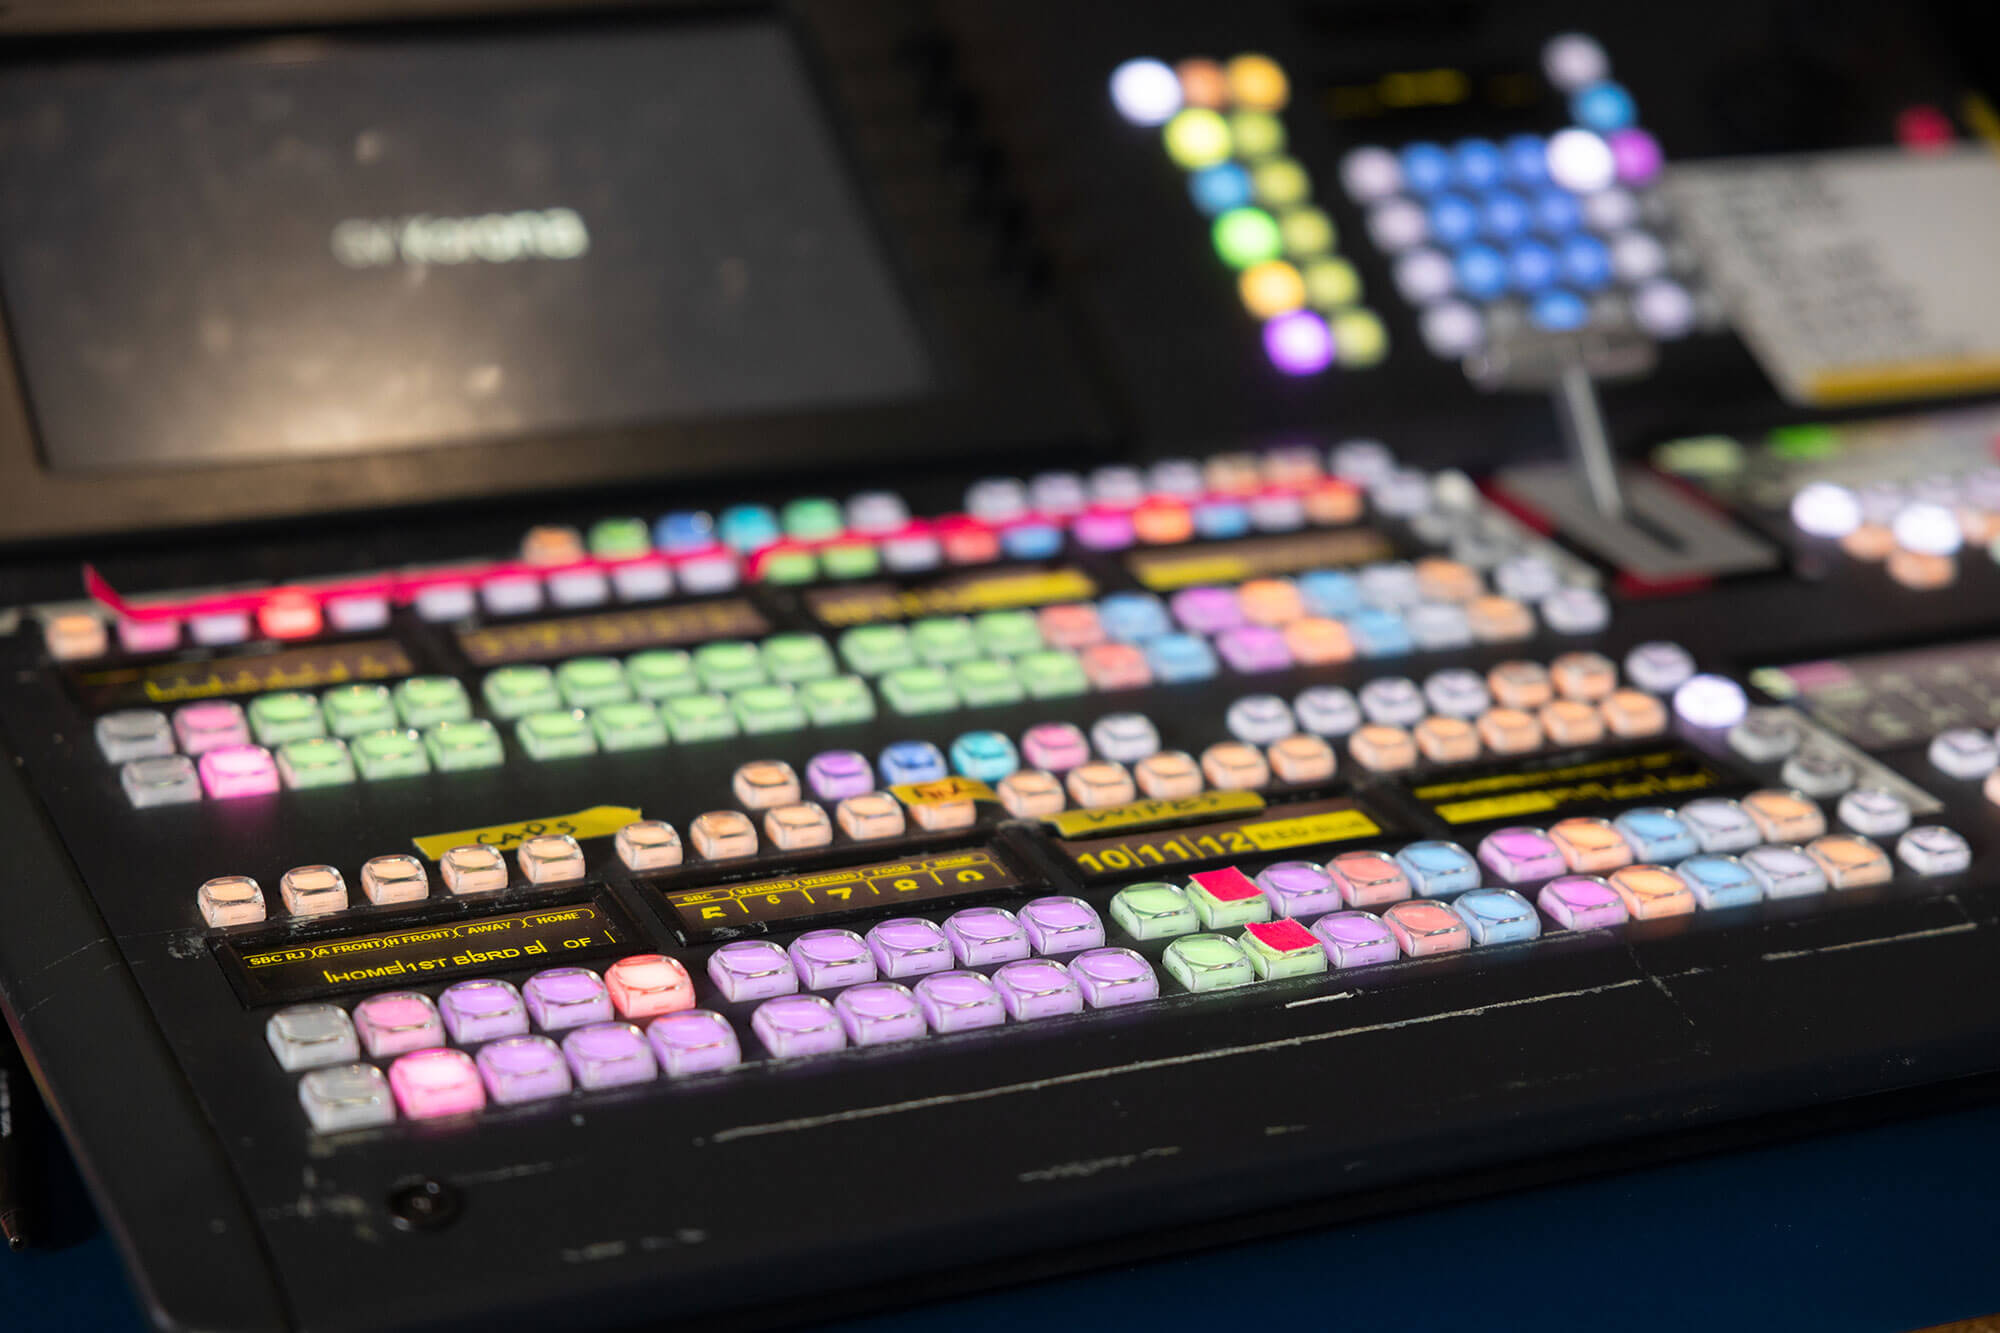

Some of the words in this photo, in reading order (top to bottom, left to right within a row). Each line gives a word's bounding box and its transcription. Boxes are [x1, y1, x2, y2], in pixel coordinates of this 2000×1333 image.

[800, 872, 857, 886] VERSUS
[735, 882, 793, 895] VERSUS
[767, 894, 781, 904] 6
[536, 912, 581, 925] HOME
[467, 921, 512, 935] AWAY
[388, 936, 400, 946] H
[401, 930, 450, 945] FRONT
[563, 937, 592, 949] OF
[318, 948, 330, 957] A
[332, 939, 384, 954] FRONT
[250, 955, 283, 966] SBC
[286, 951, 307, 962] RJ
[406, 956, 449, 971] 1ST
[330, 965, 402, 984] HOME
